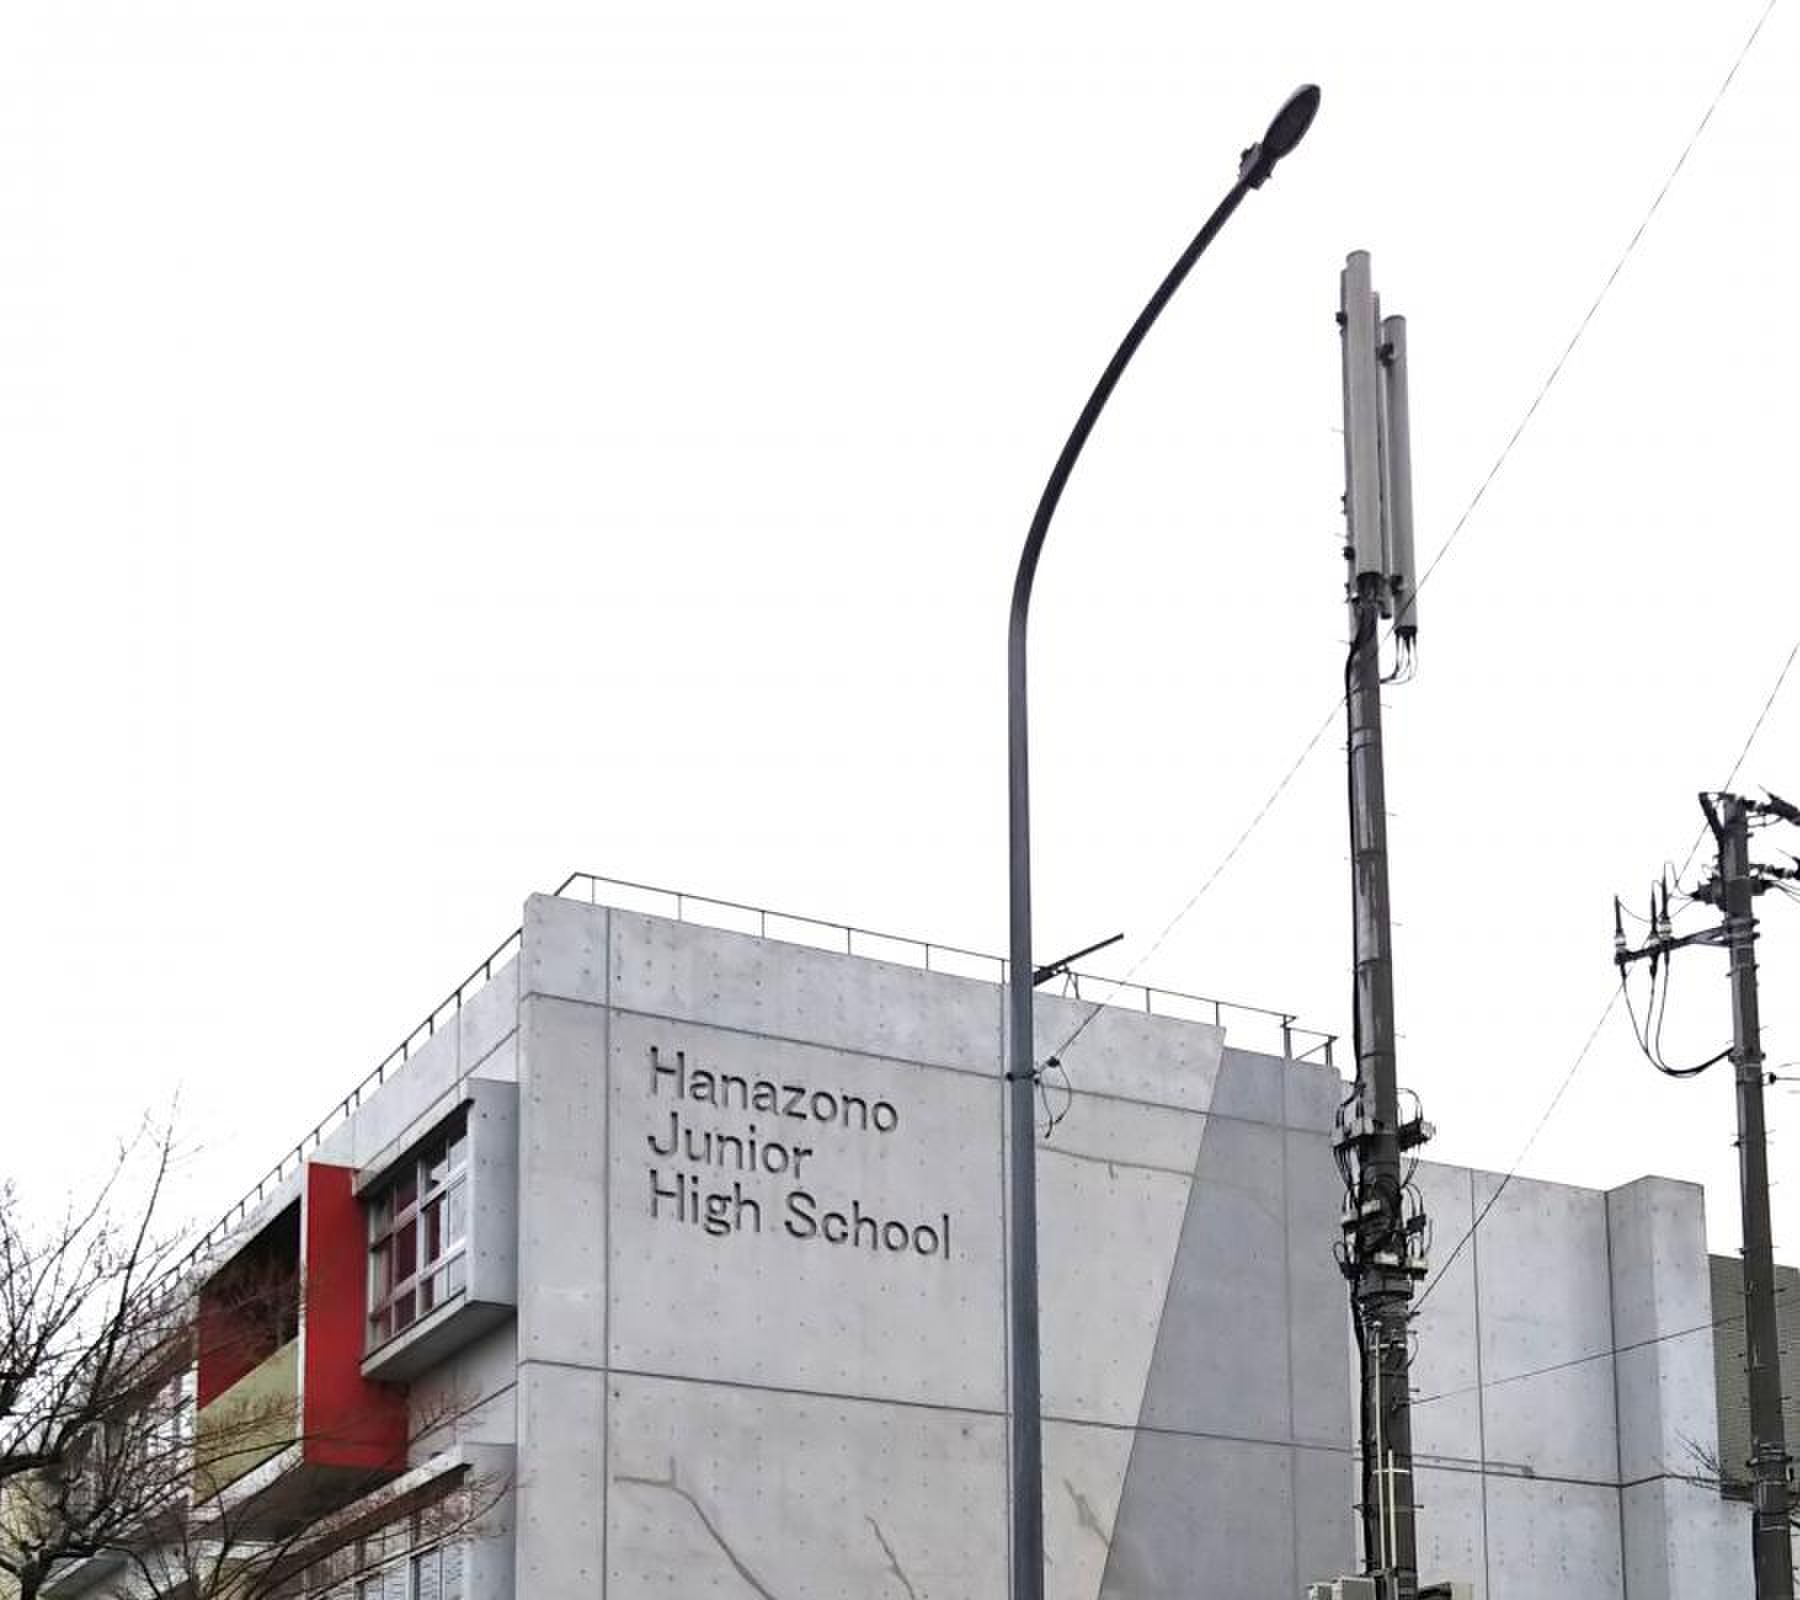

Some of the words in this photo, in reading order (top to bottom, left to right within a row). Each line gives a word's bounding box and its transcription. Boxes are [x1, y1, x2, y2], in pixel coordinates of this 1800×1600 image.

[650, 1046, 899, 1132] Hanazono
[647, 1111, 813, 1179] Junior
[649, 1169, 761, 1236] High
[784, 1190, 951, 1260] School
